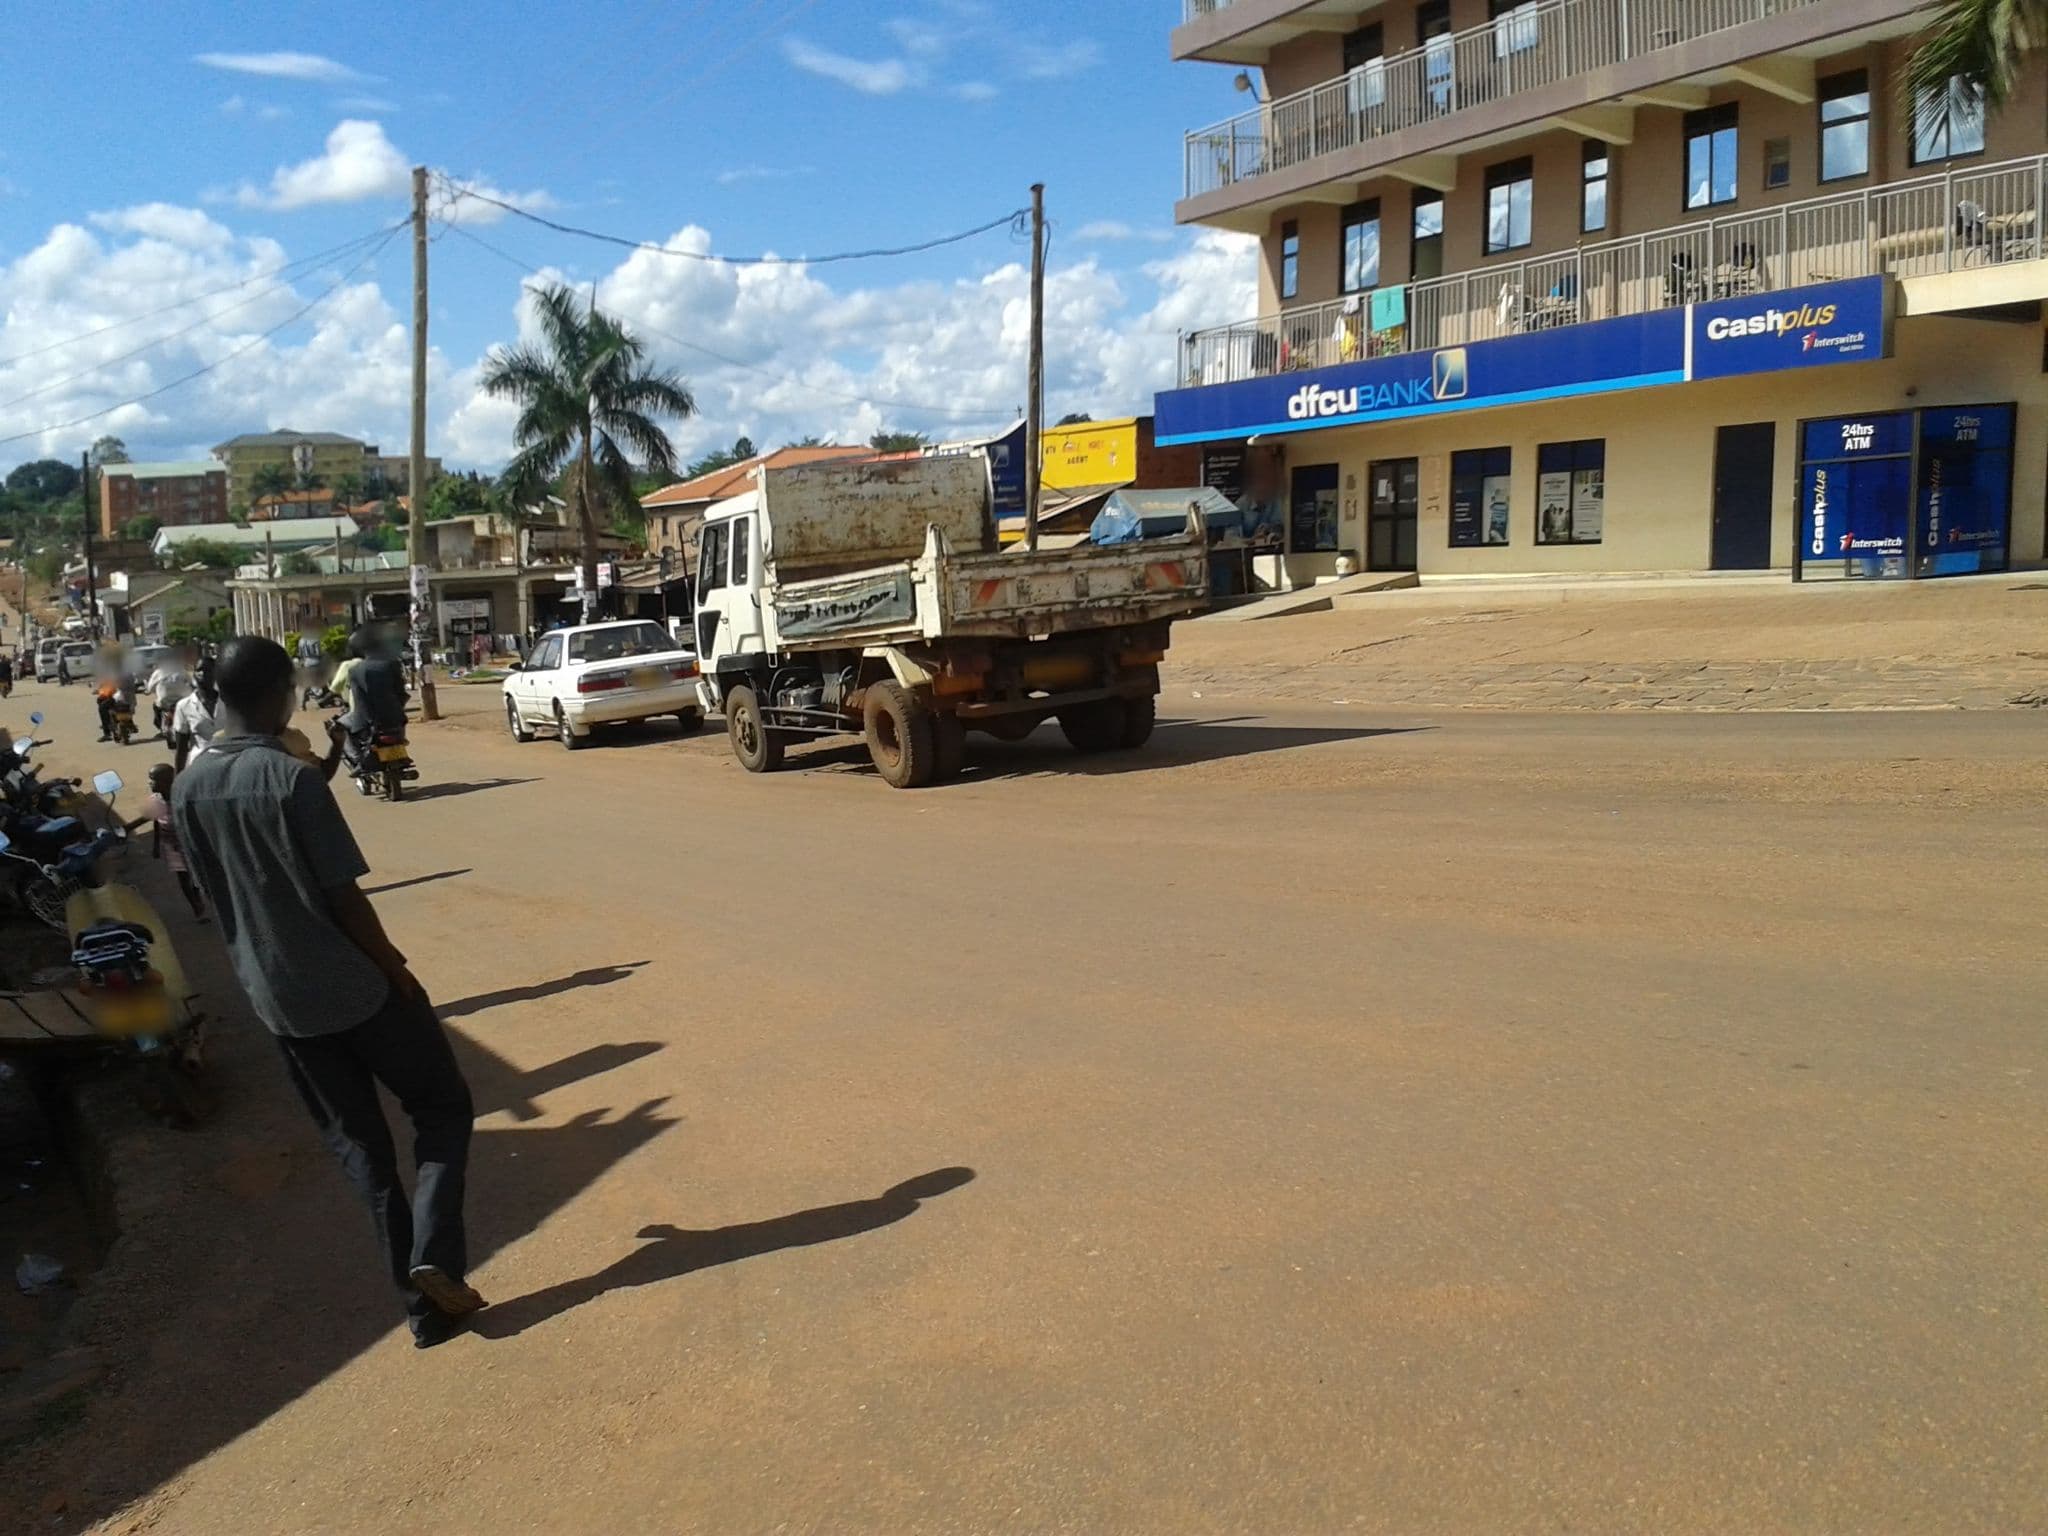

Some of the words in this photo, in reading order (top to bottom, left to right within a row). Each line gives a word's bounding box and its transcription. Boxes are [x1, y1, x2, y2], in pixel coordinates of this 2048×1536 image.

[1707, 303, 1837, 340] Cashplus
[1813, 331, 1865, 348] Interswitch
[1953, 415, 1981, 428] 24hrs
[1841, 424, 1875, 438] 24hrs
[1956, 427, 1978, 441] ATM
[1844, 436, 1871, 451] ATM
[1812, 469, 1828, 555] Cashplus
[1850, 536, 1903, 549] Interswitch
